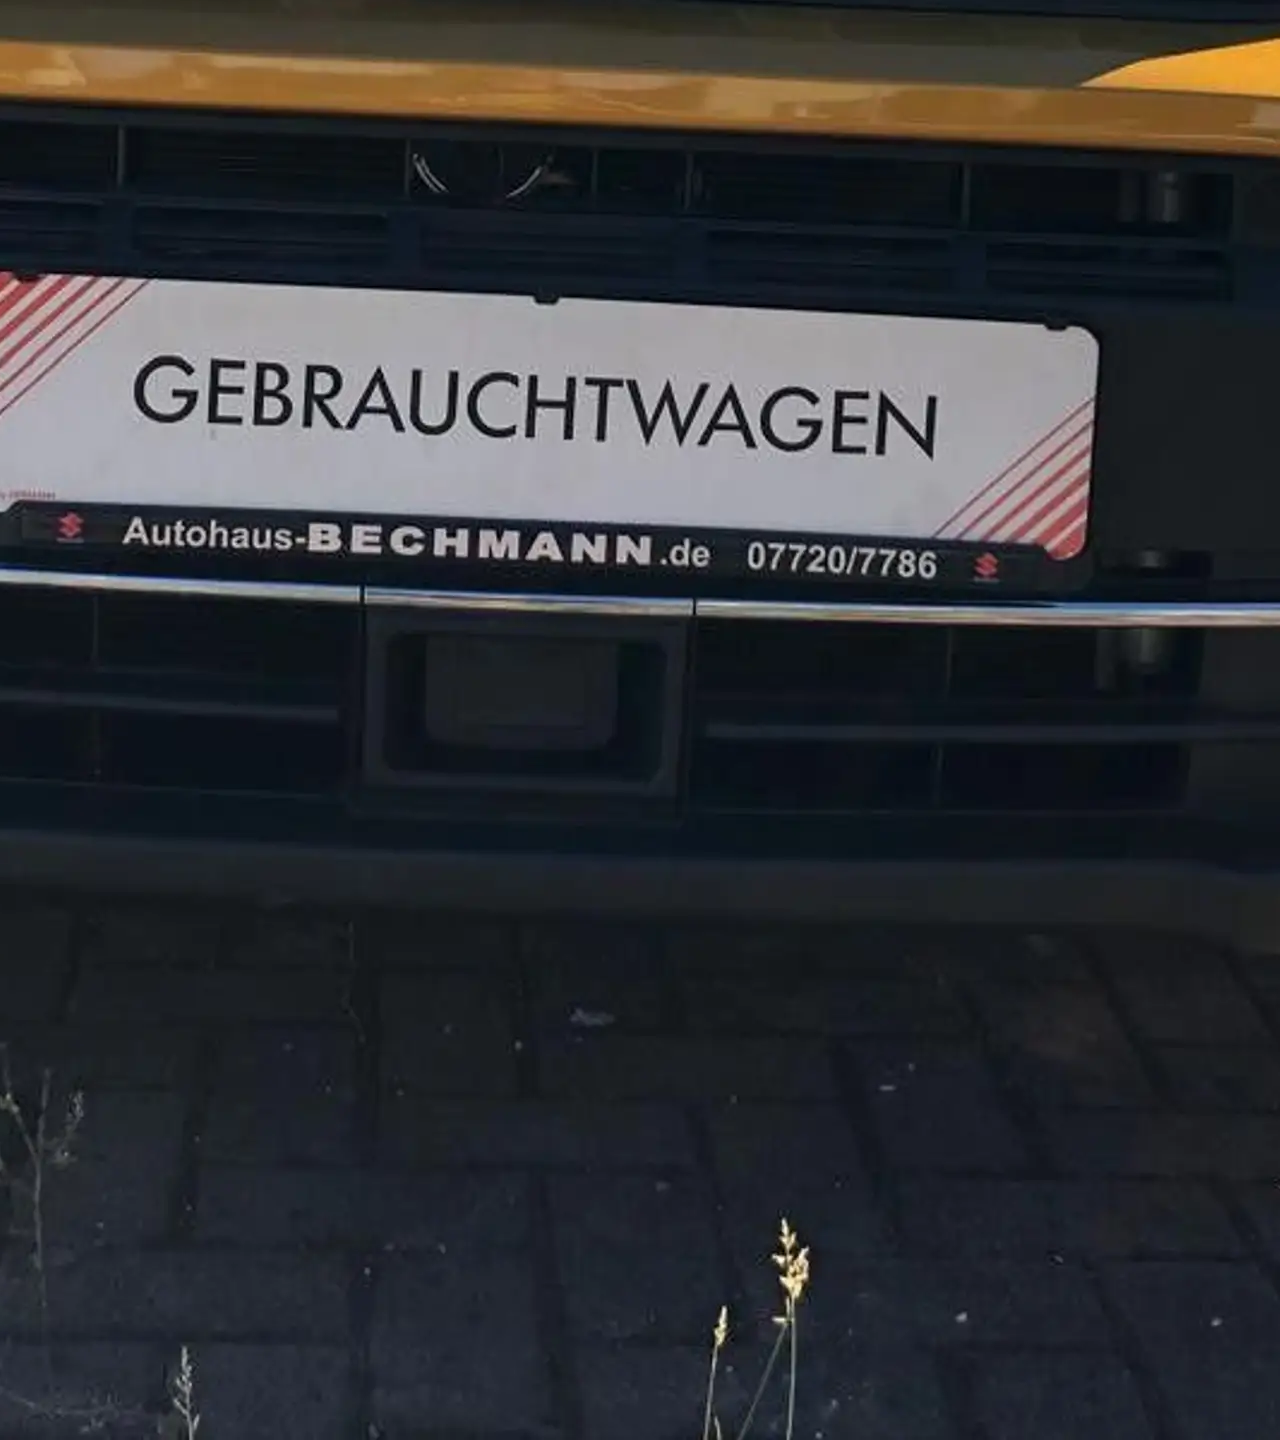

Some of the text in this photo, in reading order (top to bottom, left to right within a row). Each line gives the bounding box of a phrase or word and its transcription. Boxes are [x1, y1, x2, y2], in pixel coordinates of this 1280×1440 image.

[133, 355, 938, 460] GEBRAUCHTWAGEN
[121, 516, 937, 579] Autohaus-BECHMANN.de 07720/7786
